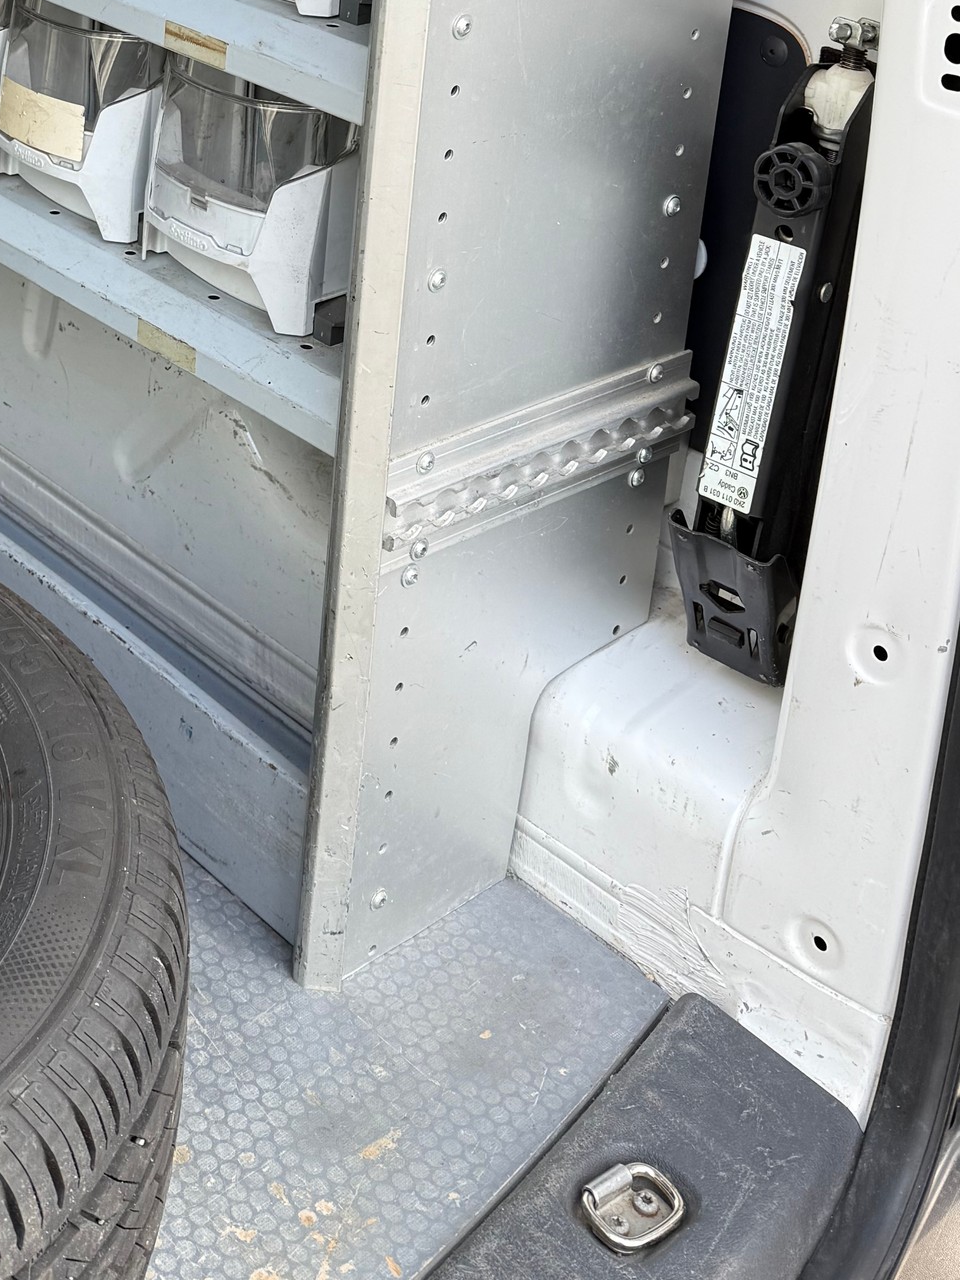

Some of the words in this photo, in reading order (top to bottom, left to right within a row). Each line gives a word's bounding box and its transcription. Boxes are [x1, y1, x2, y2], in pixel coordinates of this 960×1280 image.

[168, 223, 209, 251] Sortimo
[708, 462, 720, 472] CZ
[725, 469, 738, 480] BN3
[703, 484, 709, 492] B
[718, 478, 735, 492] Caddy
[710, 487, 721, 497] 031
[722, 492, 733, 502] 011
[47, 820, 106, 886] XL
